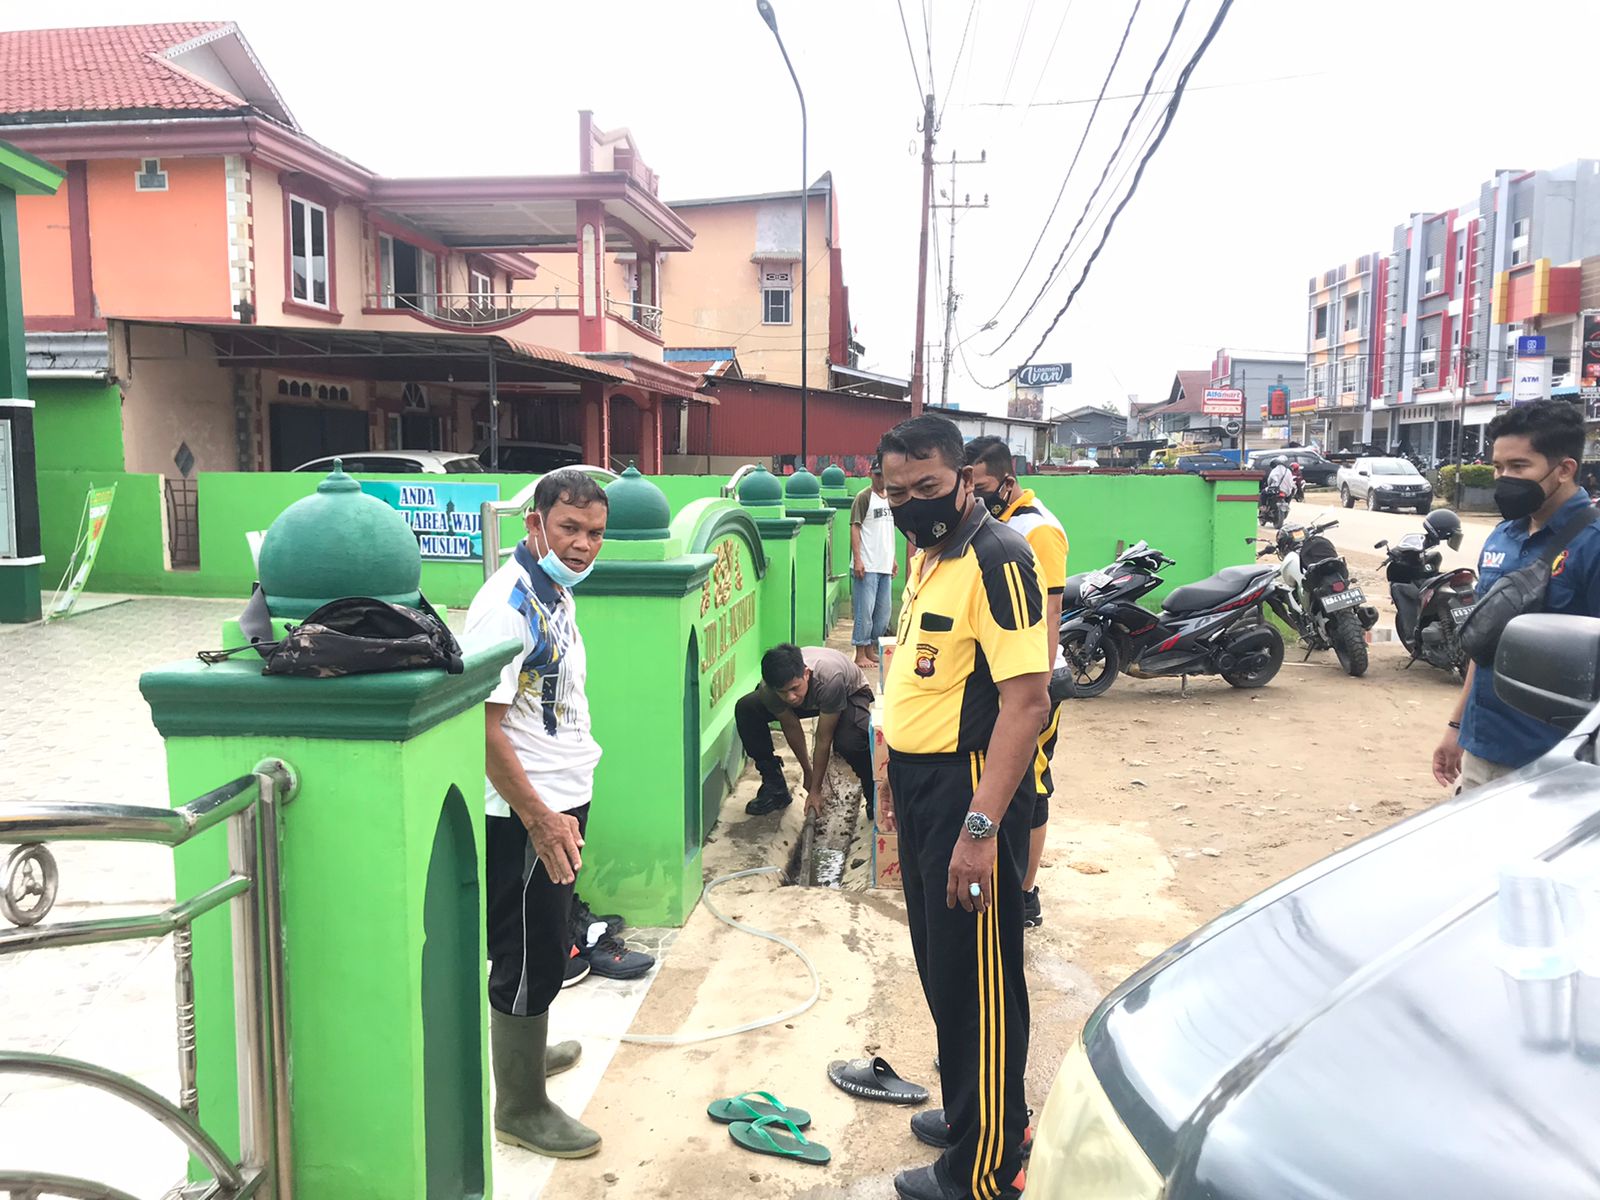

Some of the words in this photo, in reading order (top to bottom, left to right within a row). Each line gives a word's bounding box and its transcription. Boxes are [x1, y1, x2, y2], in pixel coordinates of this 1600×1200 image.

[401, 488, 435, 505] ANDA
[414, 513, 447, 530] AREA
[452, 513, 482, 533] WAJI
[421, 536, 469, 555] MUSLIM
[1483, 551, 1506, 565] DVI
[856, 1085, 864, 1093] IS
[864, 1088, 886, 1096] CLOSER
